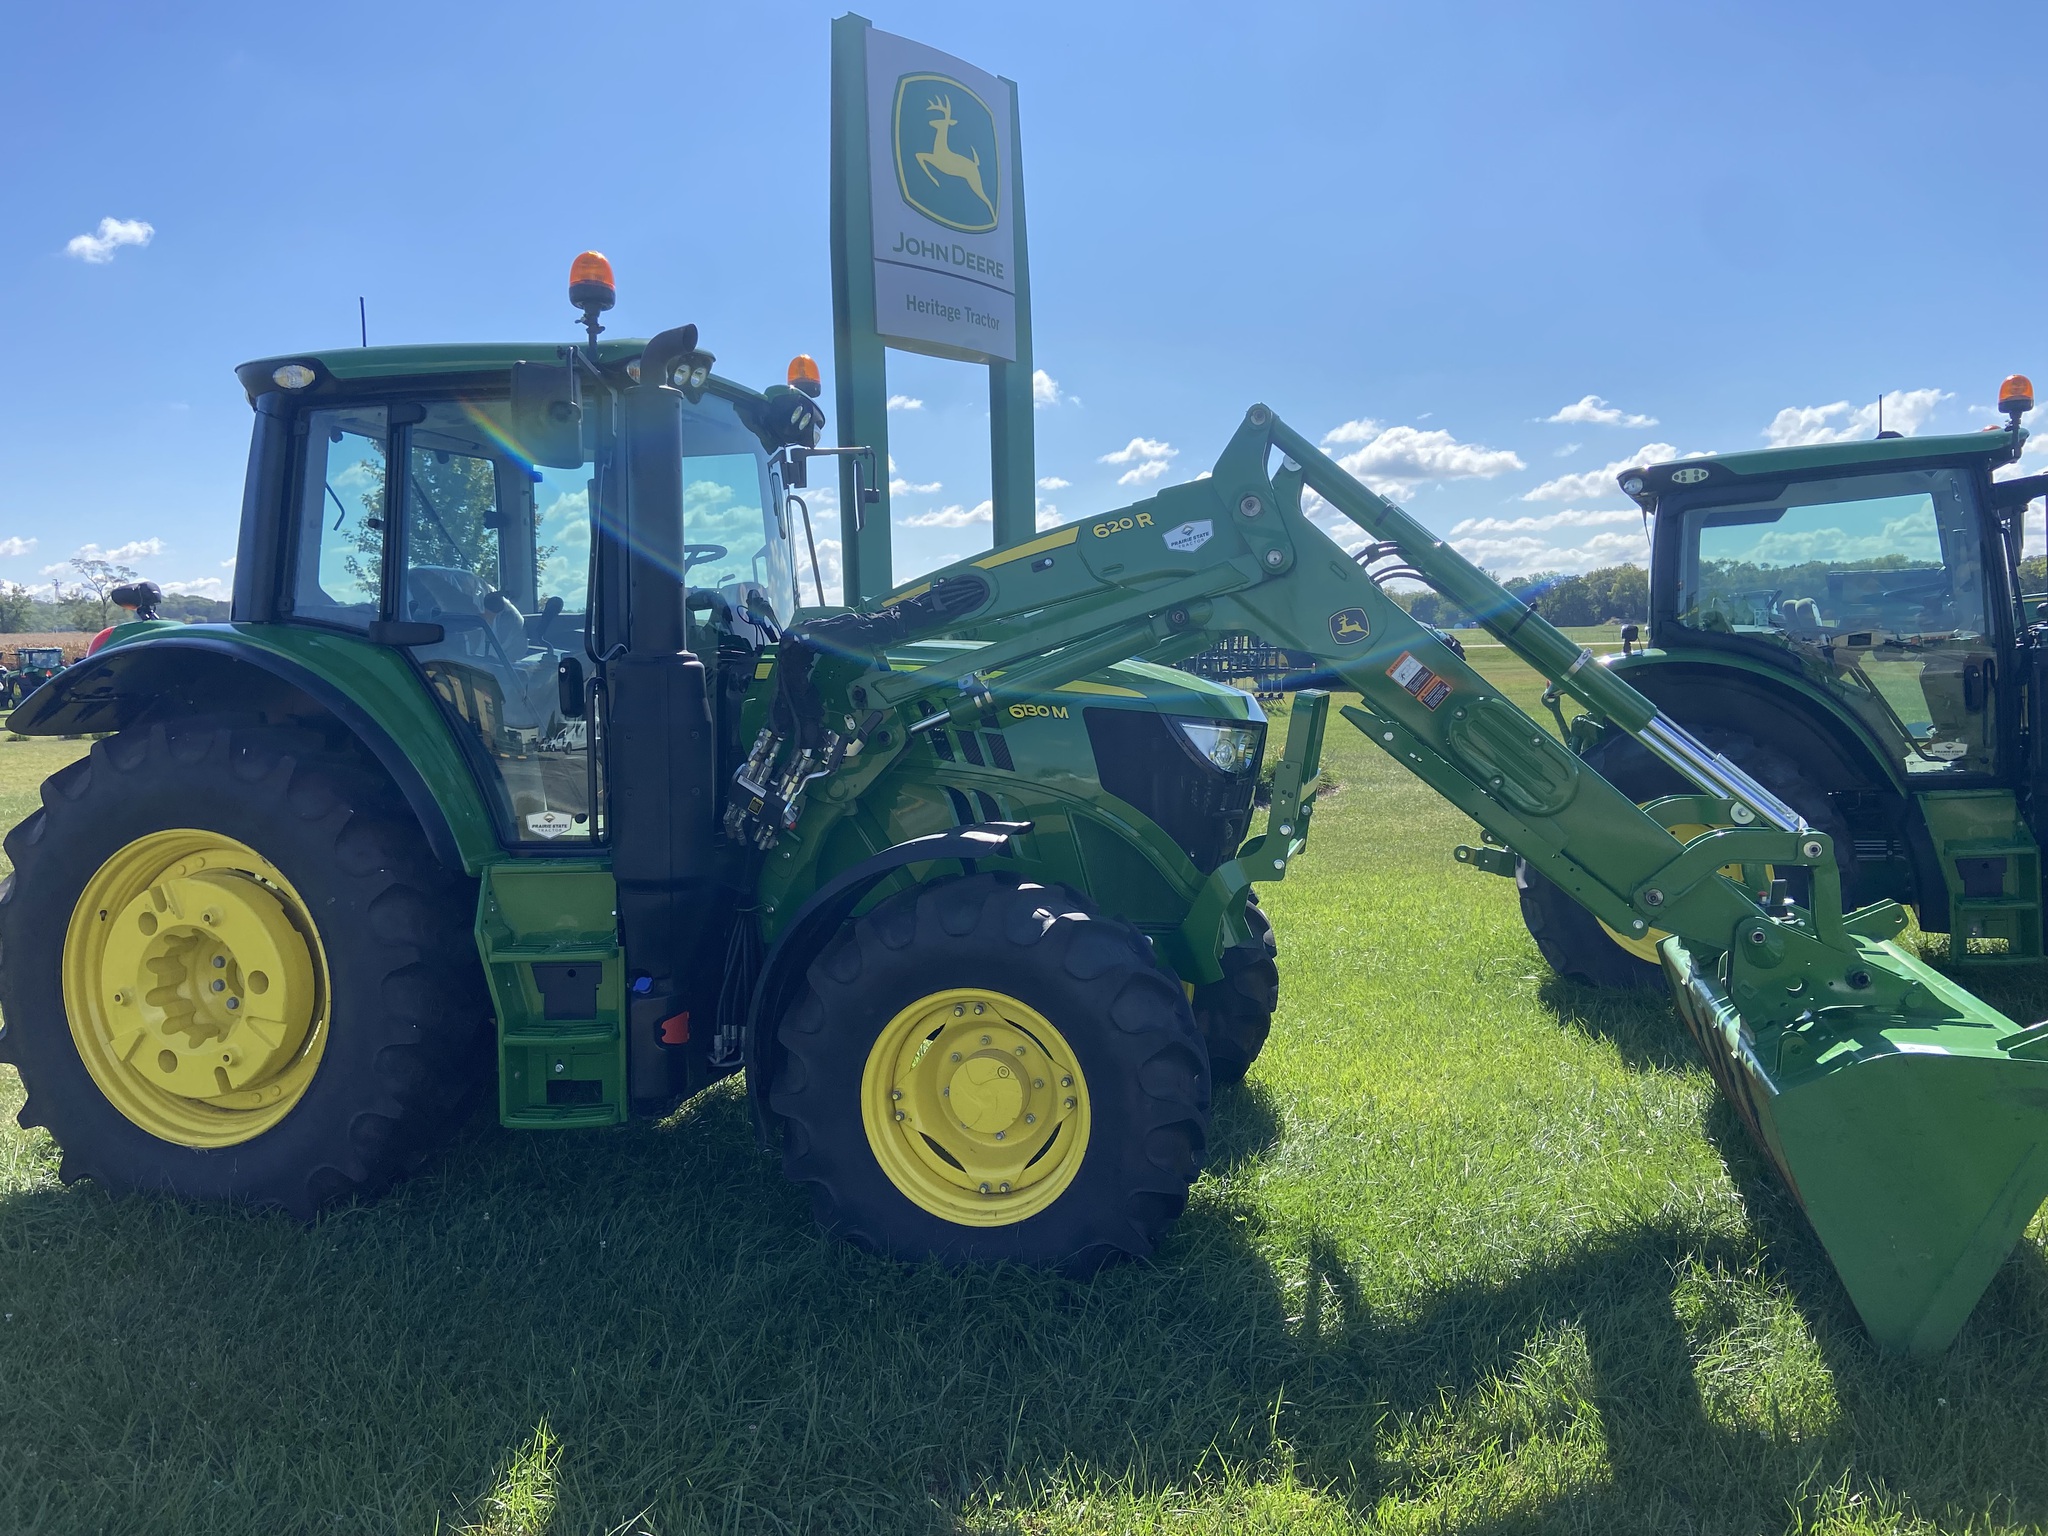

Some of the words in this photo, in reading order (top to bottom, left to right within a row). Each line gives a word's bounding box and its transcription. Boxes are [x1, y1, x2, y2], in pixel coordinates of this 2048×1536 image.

[892, 231, 949, 263] JOHN
[952, 244, 1004, 280] DEERE
[906, 294, 961, 322] Heritage
[964, 306, 1000, 331] Tractor
[1092, 517, 1134, 538] 620
[1135, 512, 1155, 528] R
[1171, 535, 1193, 547] PRAIRIE
[1193, 531, 1210, 541] STATE
[1009, 703, 1050, 719] 6130
[1051, 705, 1069, 719] M
